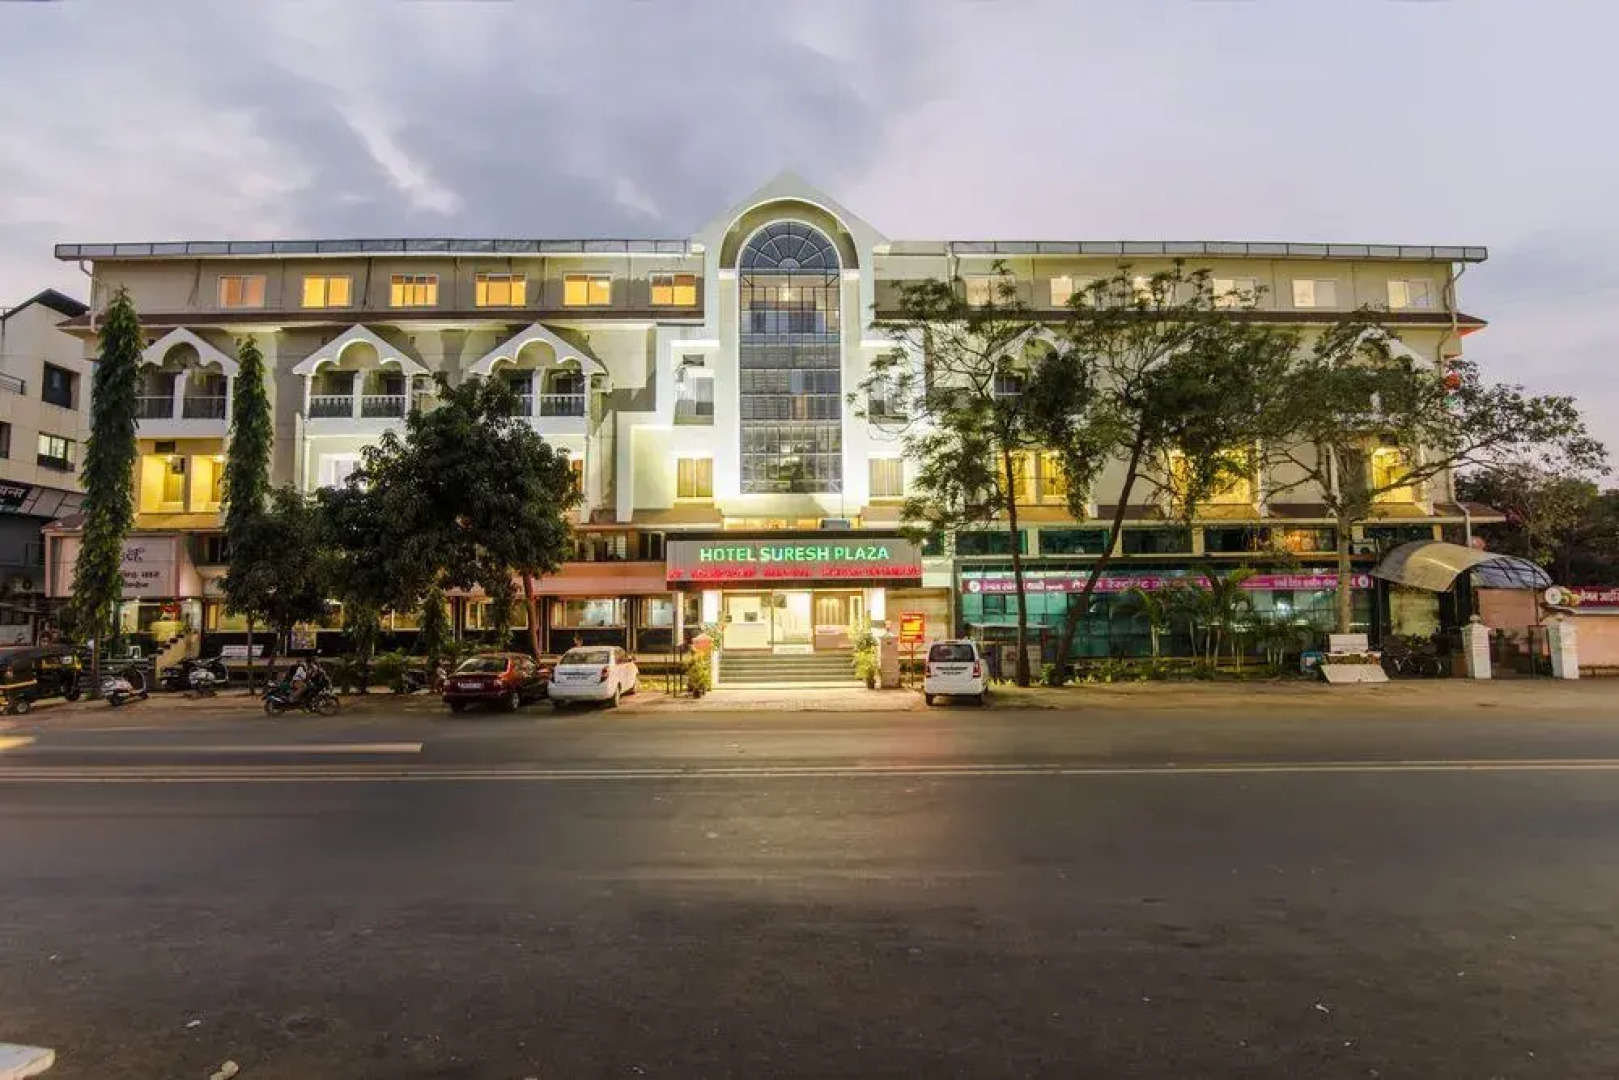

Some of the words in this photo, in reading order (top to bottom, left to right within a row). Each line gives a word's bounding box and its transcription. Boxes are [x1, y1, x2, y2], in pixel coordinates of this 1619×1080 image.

[700, 548, 757, 562] HOTEL
[760, 547, 830, 562] SURESH
[835, 546, 890, 560] PLAZA
